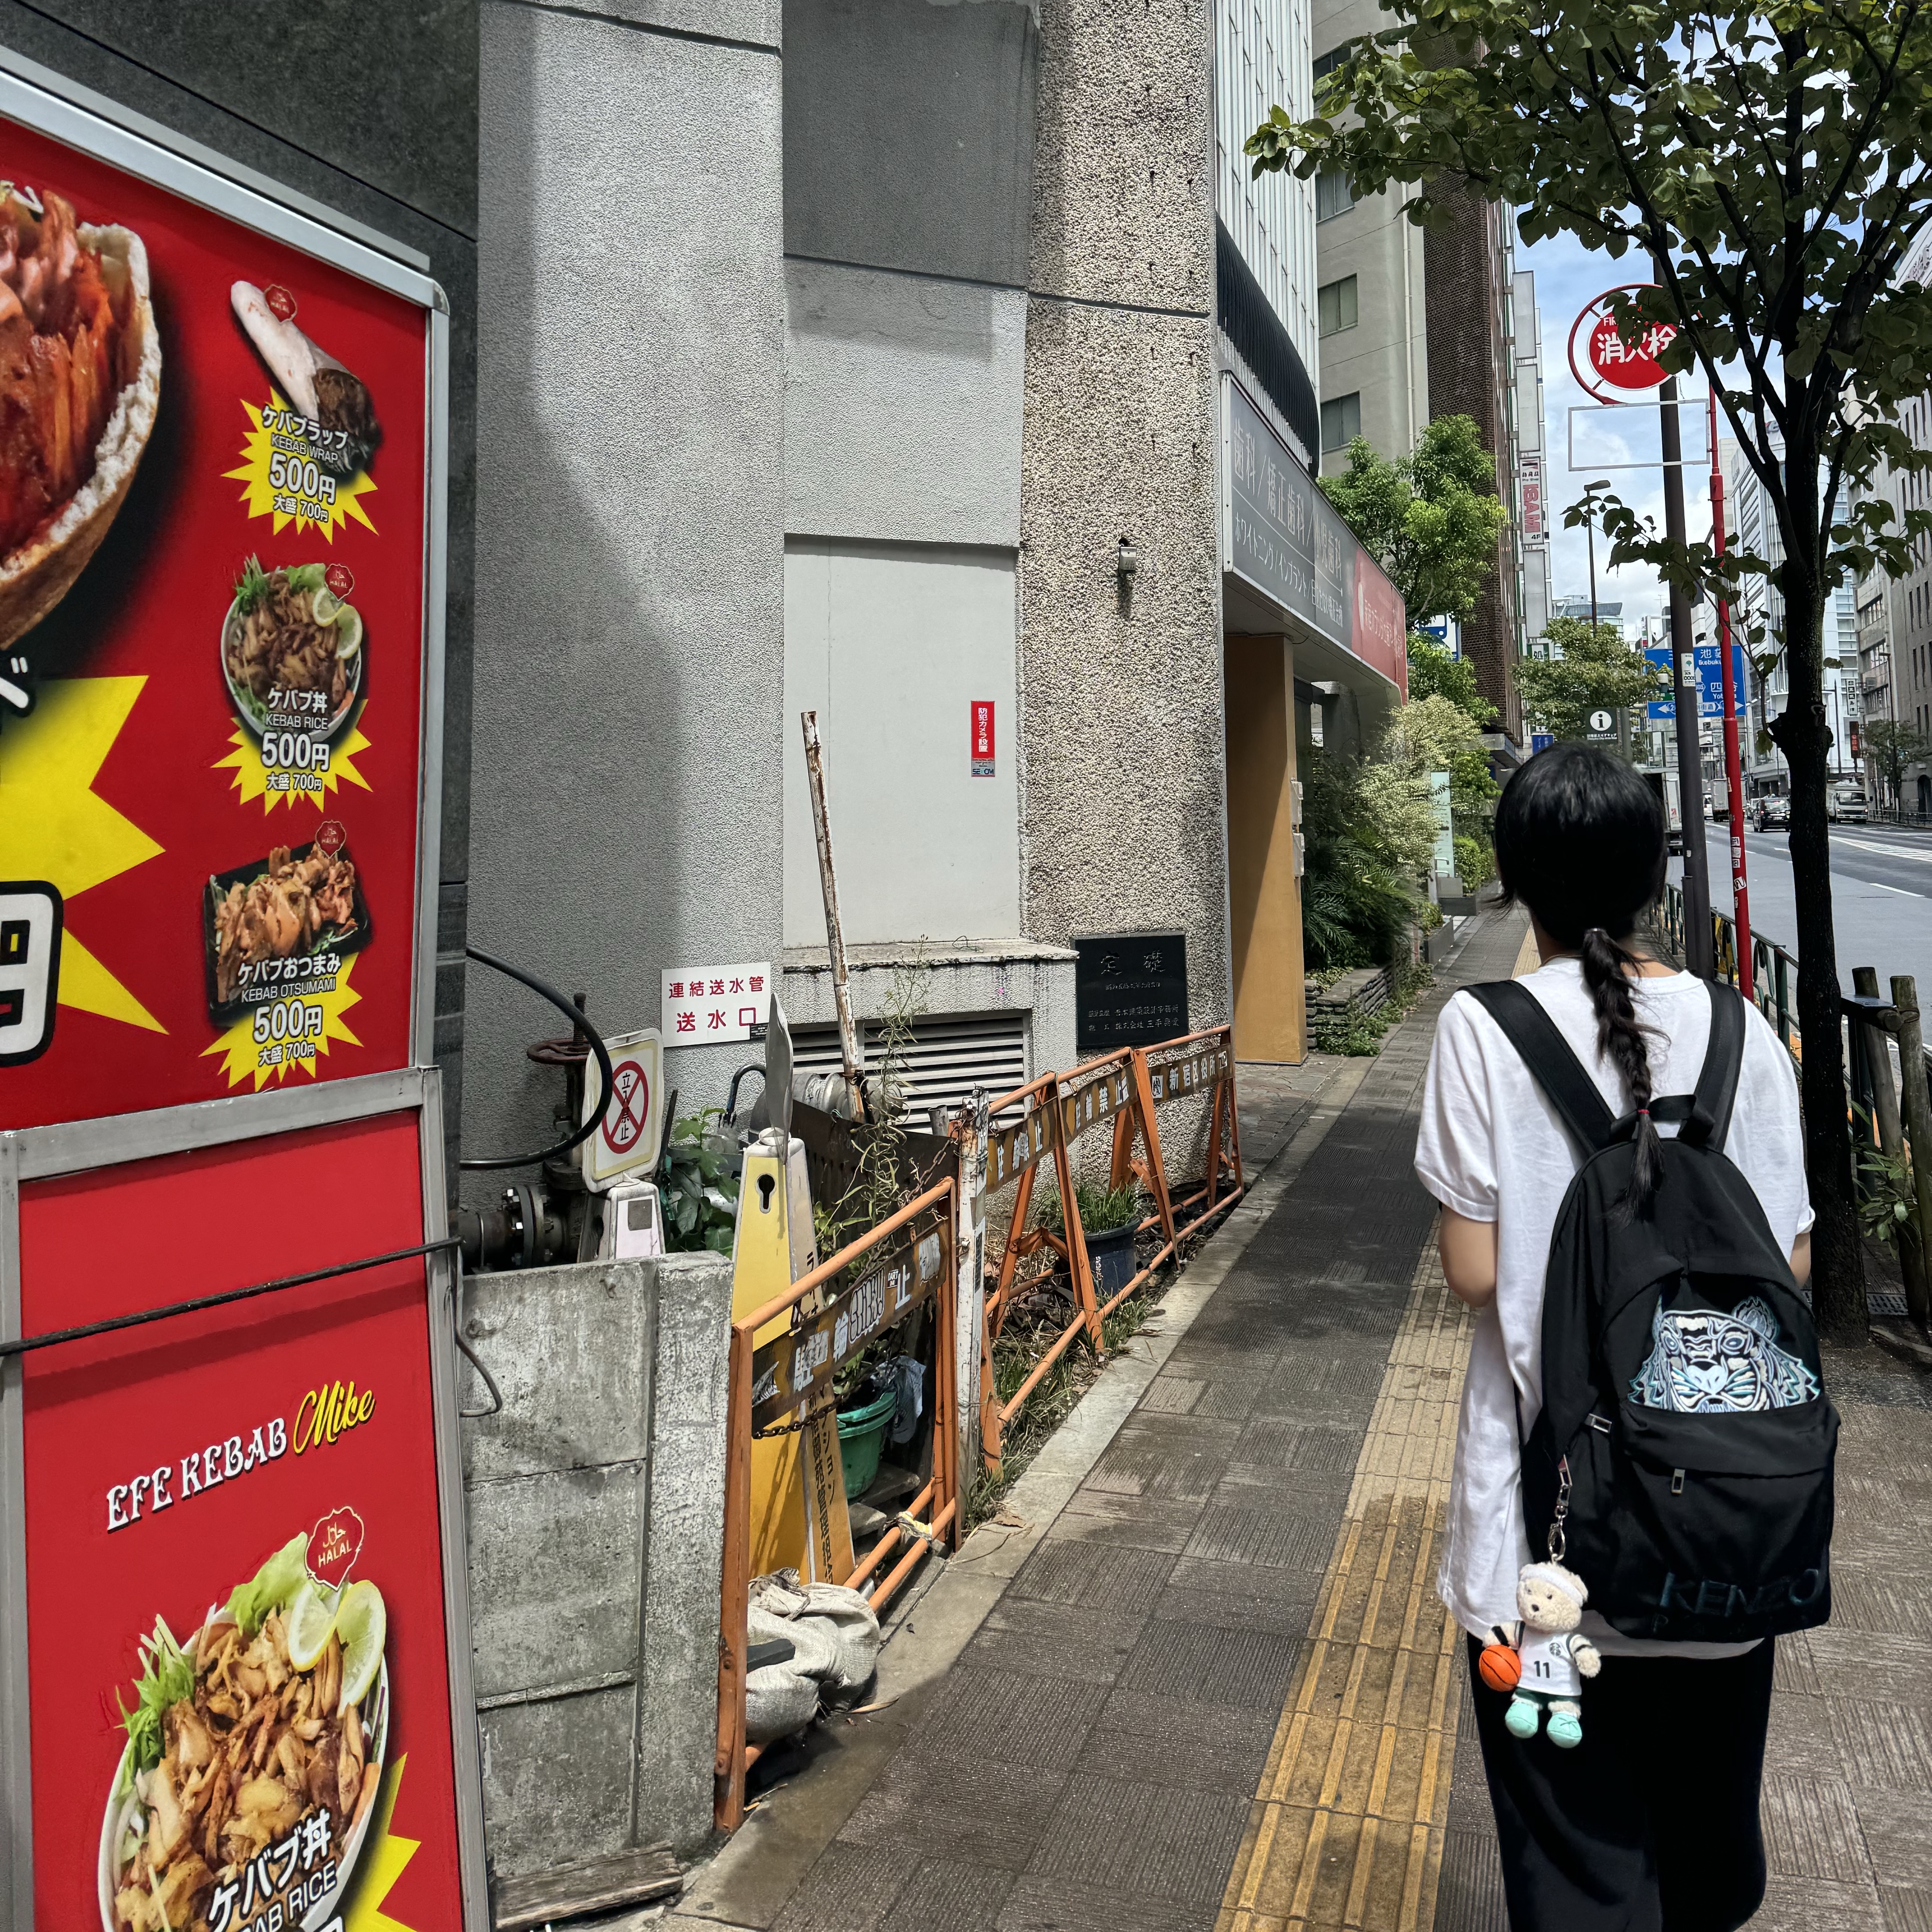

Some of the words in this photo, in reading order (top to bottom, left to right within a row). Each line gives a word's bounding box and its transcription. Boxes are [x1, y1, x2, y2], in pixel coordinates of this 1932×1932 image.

[1604, 317, 1616, 326] FIR
[1597, 326, 1677, 365] 消火栓
[262, 405, 348, 449] ケバブラップ
[271, 433, 307, 455] KEBAB
[308, 444, 338, 463] WRAP
[269, 452, 337, 505] 500円
[273, 494, 297, 515] 大盛
[300, 500, 329, 523] 700円
[267, 688, 328, 714] ケバブ丼
[265, 713, 301, 728] KEBAB
[304, 716, 328, 731] RICE
[978, 707, 988, 752] 防犯カメラ設置
[261, 732, 330, 771] 500円
[267, 773, 290, 791] 大盛
[293, 774, 323, 792] 700円
[237, 952, 341, 986] ケバブおつまみ
[241, 985, 278, 1003] KEBAB
[280, 978, 336, 998] OTSUMAMI
[669, 976, 764, 998] 連結送水管
[253, 1000, 323, 1044] 500円
[677, 1007, 756, 1032] 送水口
[258, 1045, 282, 1067] 大盛
[286, 1040, 316, 1060] 700円
[107, 1466, 173, 1533] EFE
[180, 1417, 287, 1500] KEBAB
[293, 1380, 376, 1454] Mike
[318, 1539, 352, 1568] HALAL
[1534, 1660, 1550, 1679] 11
[208, 1808, 331, 1932] ケバブ丼
[289, 1860, 337, 1920] RICE
